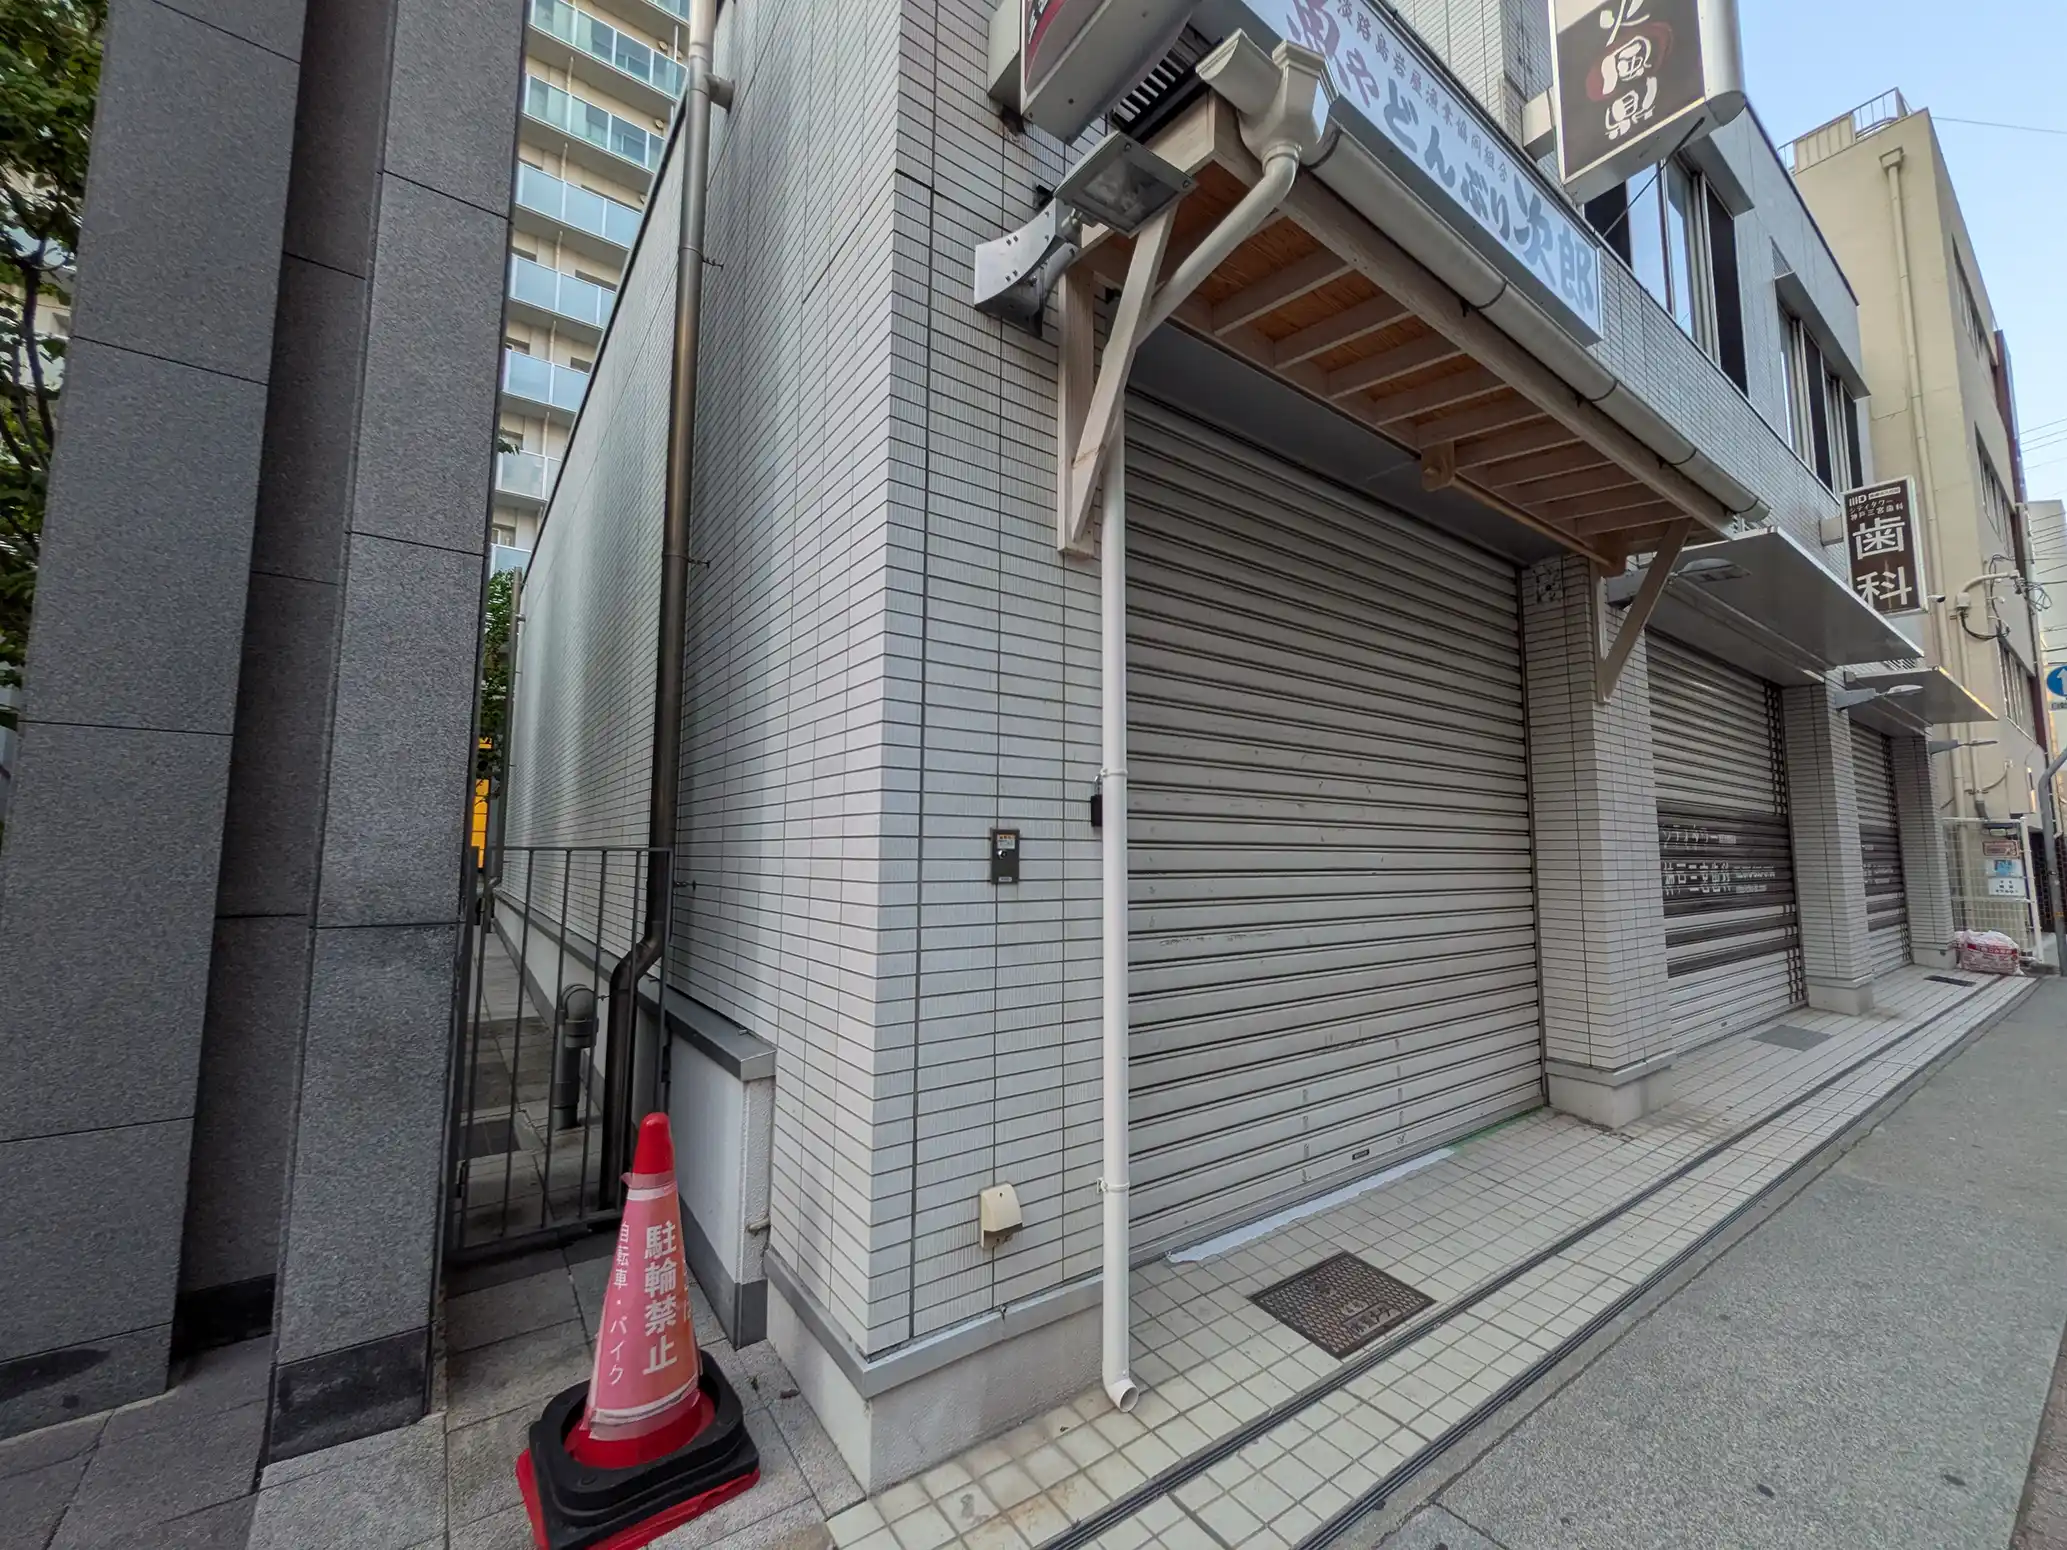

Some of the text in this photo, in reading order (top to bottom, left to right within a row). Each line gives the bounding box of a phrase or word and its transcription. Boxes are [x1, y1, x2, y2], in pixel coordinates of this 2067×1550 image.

[1852, 516, 1912, 609] 歯科
[609, 1222, 630, 1386] 自転車・バイク
[642, 1220, 678, 1376] 駐輪禁止
